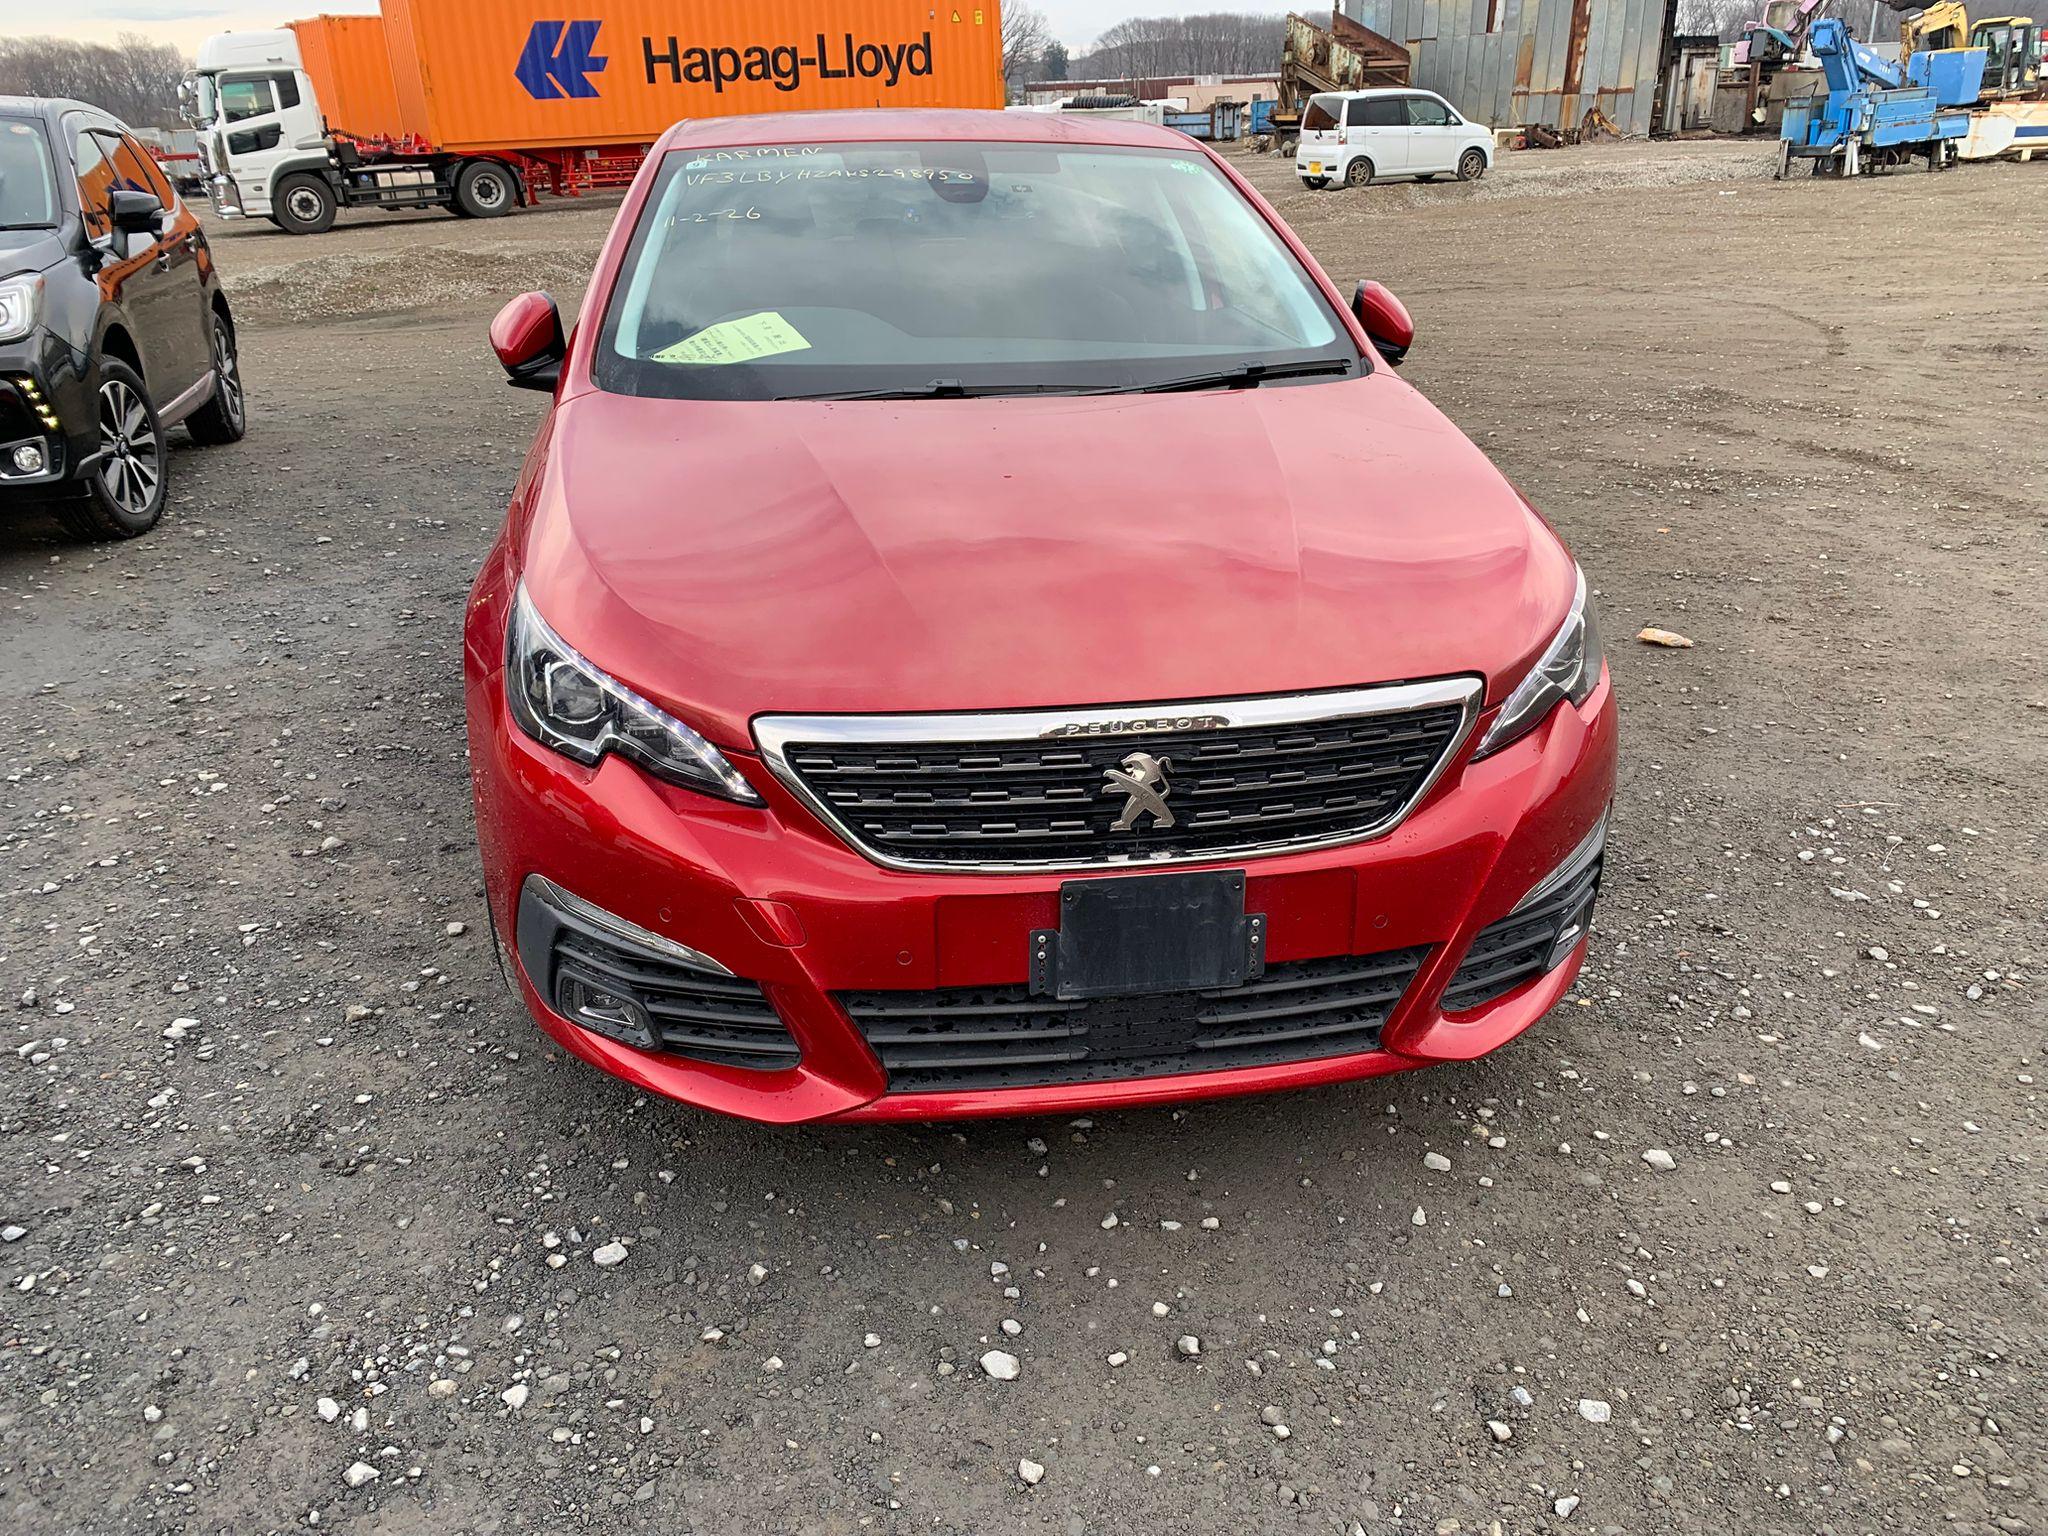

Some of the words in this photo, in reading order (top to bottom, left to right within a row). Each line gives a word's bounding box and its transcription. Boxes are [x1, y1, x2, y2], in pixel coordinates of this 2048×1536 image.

[642, 31, 933, 94] Hapag-Lloyd
[696, 147, 824, 162] KARMEN
[664, 206, 761, 228] 11-2-26
[1065, 716, 1213, 736] PEUGEOT
